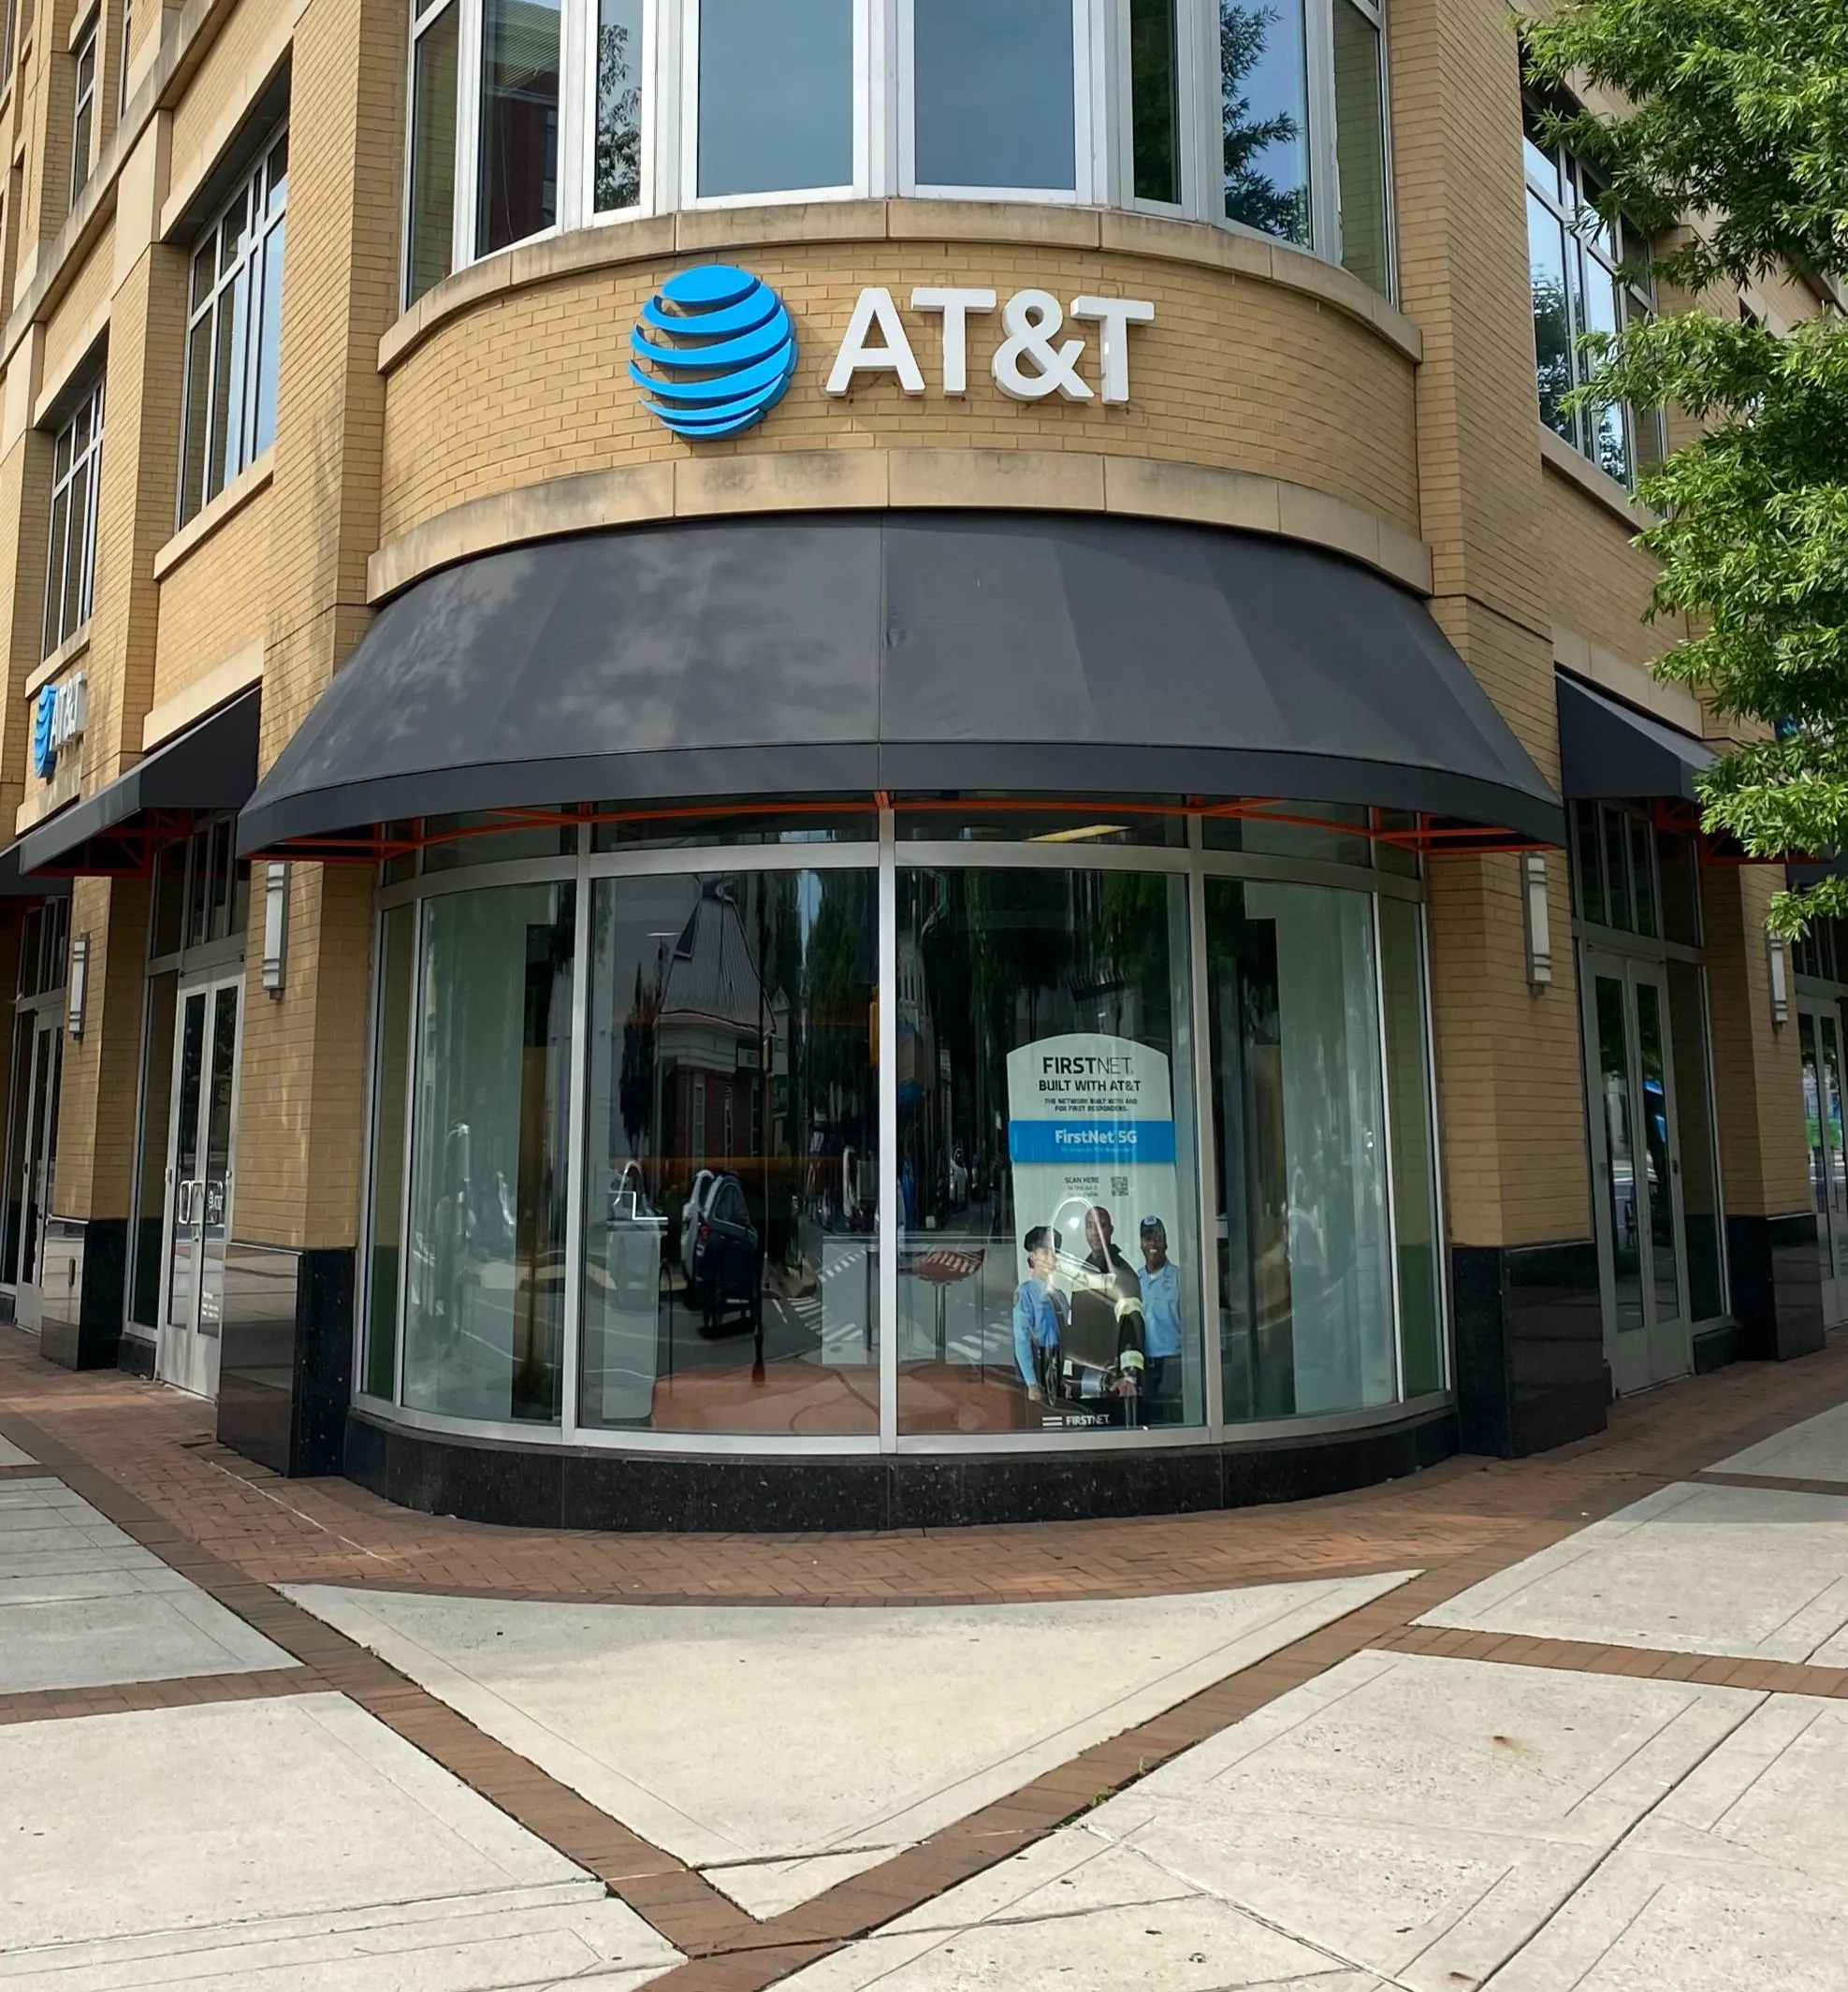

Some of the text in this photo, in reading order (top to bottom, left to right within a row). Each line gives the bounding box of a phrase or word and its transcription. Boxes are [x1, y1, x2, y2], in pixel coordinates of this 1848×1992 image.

[825, 286, 1156, 405] AT&T
[1039, 1080, 1142, 1092] BUILT WITH AT&T
[1055, 1128, 1138, 1144] FirstNet 5G
